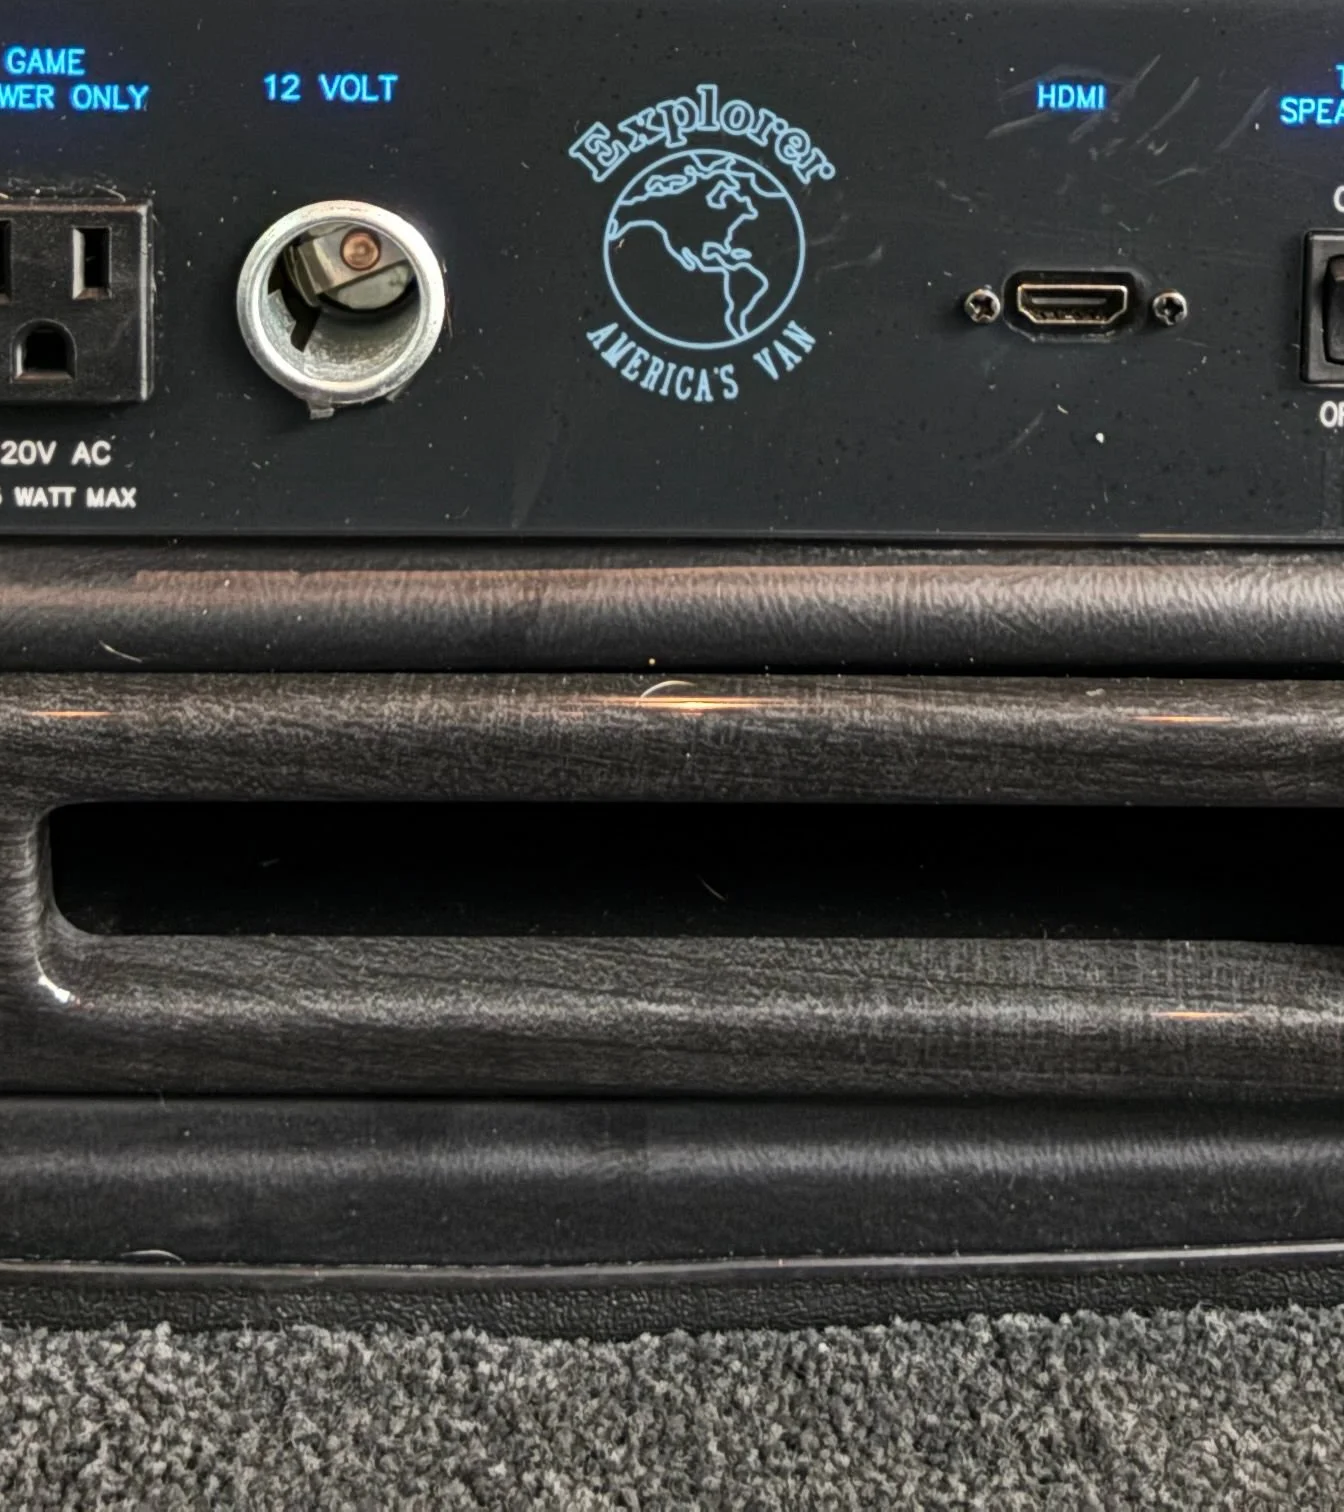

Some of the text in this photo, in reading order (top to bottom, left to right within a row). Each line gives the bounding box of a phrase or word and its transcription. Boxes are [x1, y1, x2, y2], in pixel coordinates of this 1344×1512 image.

[4, 46, 86, 76] GAME
[70, 83, 150, 111] ONLY
[263, 72, 399, 103] 12 VOLT
[1036, 83, 1107, 110] HDMI
[568, 83, 837, 185] Explorer
[586, 320, 817, 403] AMERICA'S VAN
[71, 440, 112, 466] AC
[14, 486, 77, 508] WATT
[86, 487, 137, 509] MAX
